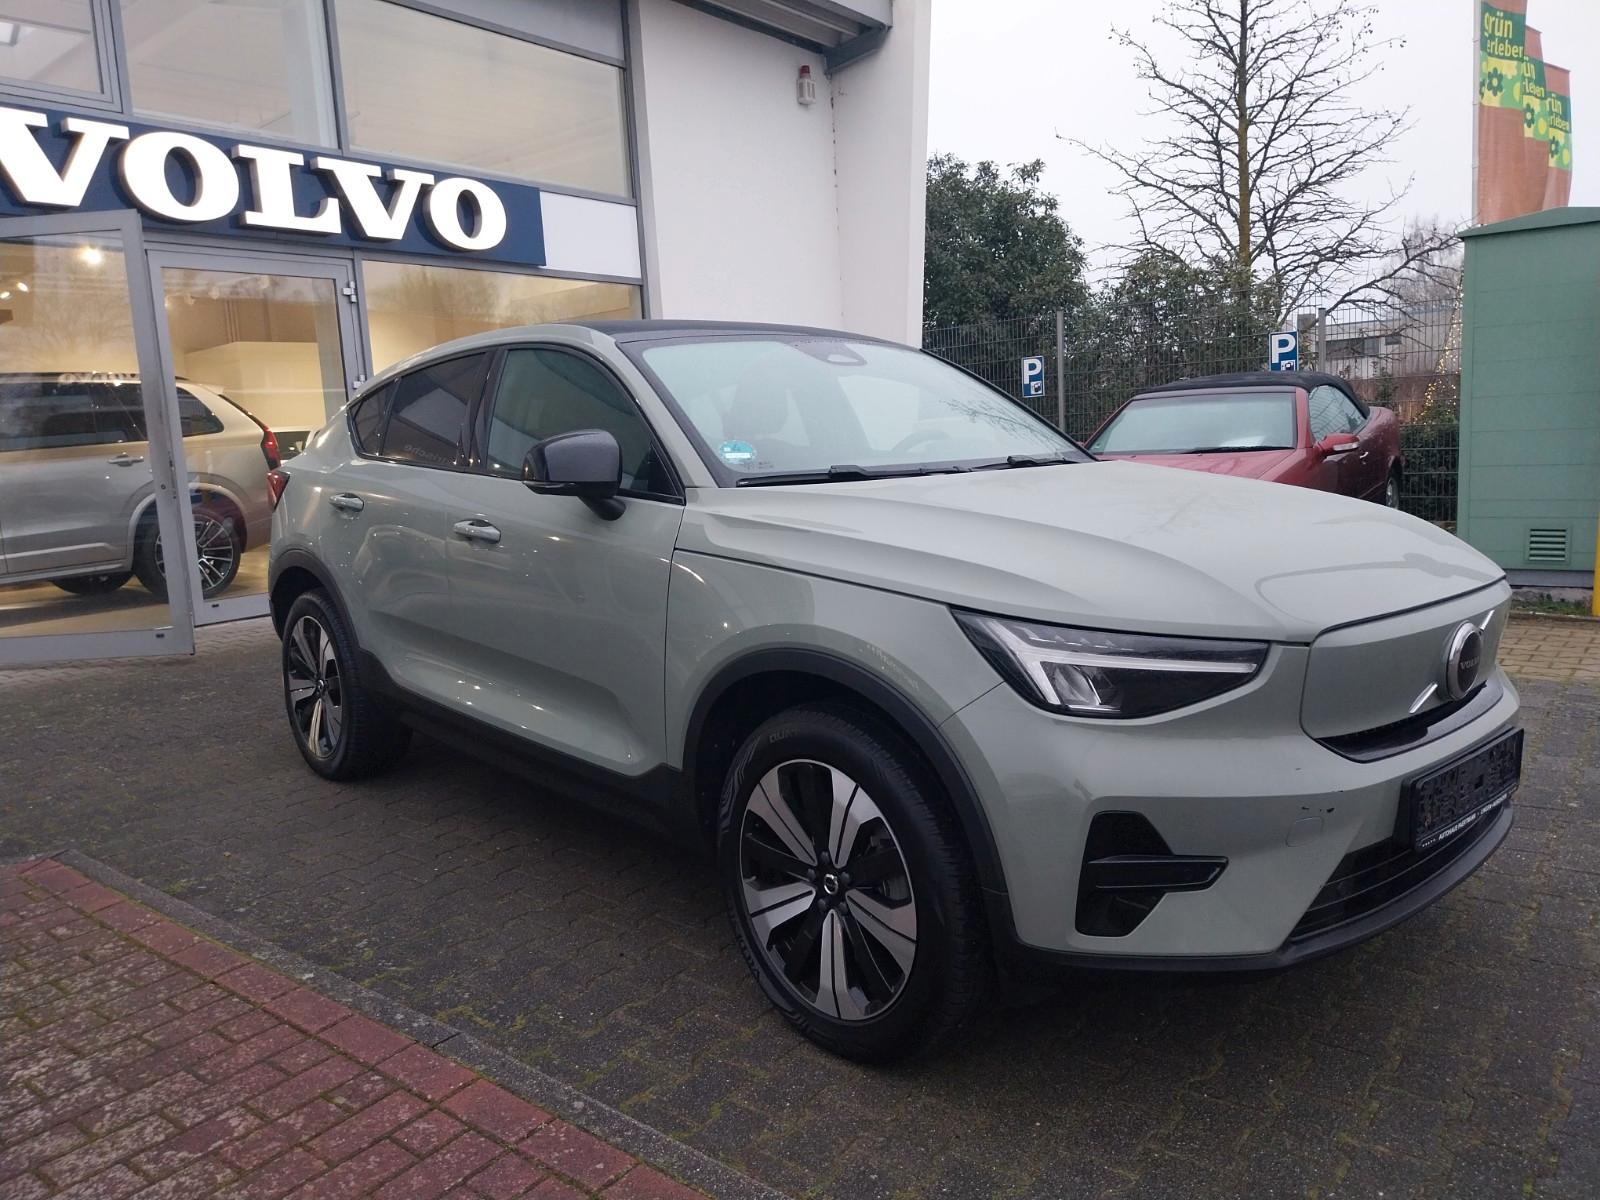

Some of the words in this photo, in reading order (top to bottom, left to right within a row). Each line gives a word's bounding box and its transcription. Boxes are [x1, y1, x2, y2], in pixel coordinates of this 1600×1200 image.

[1484, 11, 1513, 39] grün
[1546, 93, 1562, 115] rün
[0, 106, 507, 251] VOLVO
[1272, 334, 1296, 363] P
[1024, 359, 1041, 384] P
